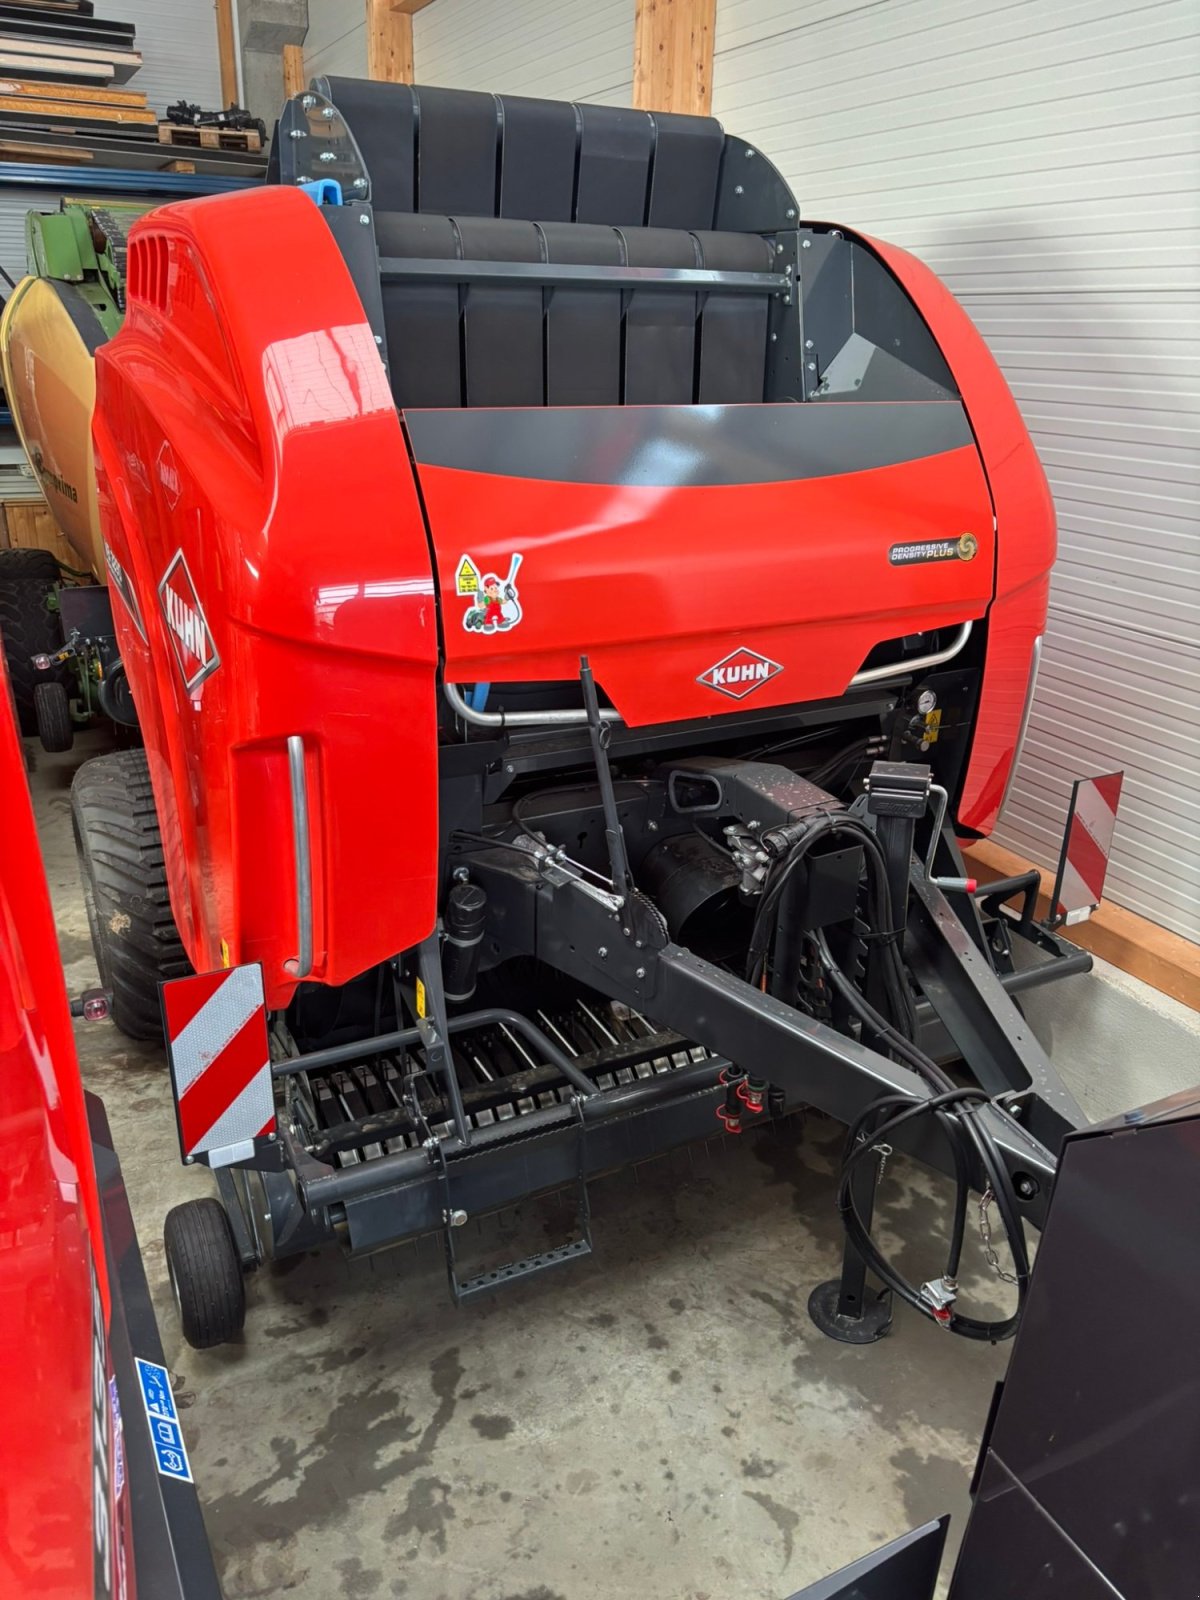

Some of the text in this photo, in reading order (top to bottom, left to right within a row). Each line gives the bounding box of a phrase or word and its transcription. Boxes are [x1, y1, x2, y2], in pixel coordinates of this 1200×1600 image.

[891, 547, 954, 561] DENSITY PLUS
[892, 542, 949, 554] PROGRESSIVE
[165, 582, 206, 668] KUHN
[712, 662, 769, 685] KUHN
